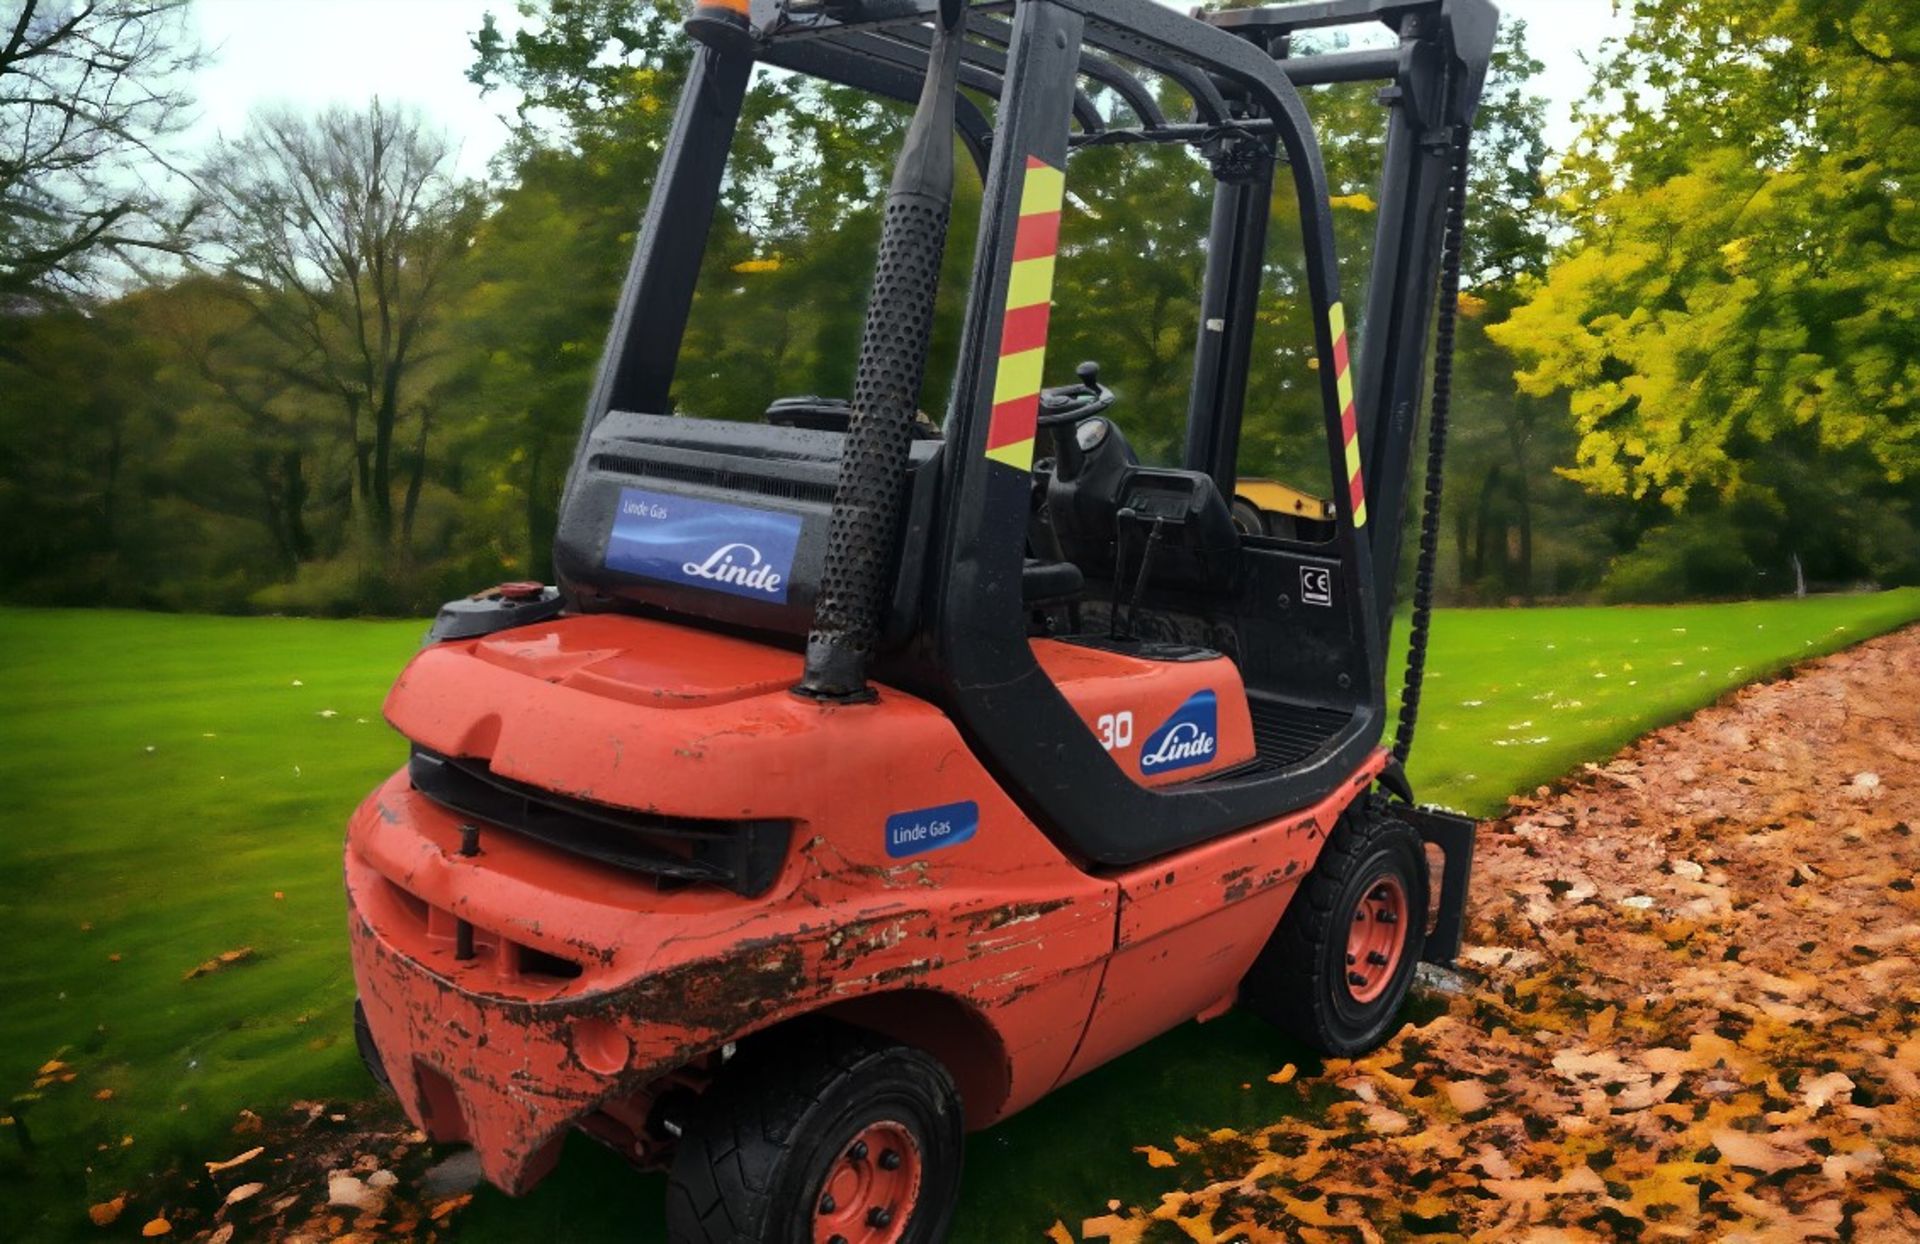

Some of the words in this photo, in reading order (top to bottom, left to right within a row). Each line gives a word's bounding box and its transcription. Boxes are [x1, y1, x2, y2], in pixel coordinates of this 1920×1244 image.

[623, 501, 648, 517] Linde
[650, 504, 668, 520] Gas
[682, 543, 781, 593] Linde
[1097, 710, 1133, 751] 30
[1142, 722, 1214, 766] Linde
[893, 823, 926, 845] Linde
[929, 820, 951, 837] Gas
